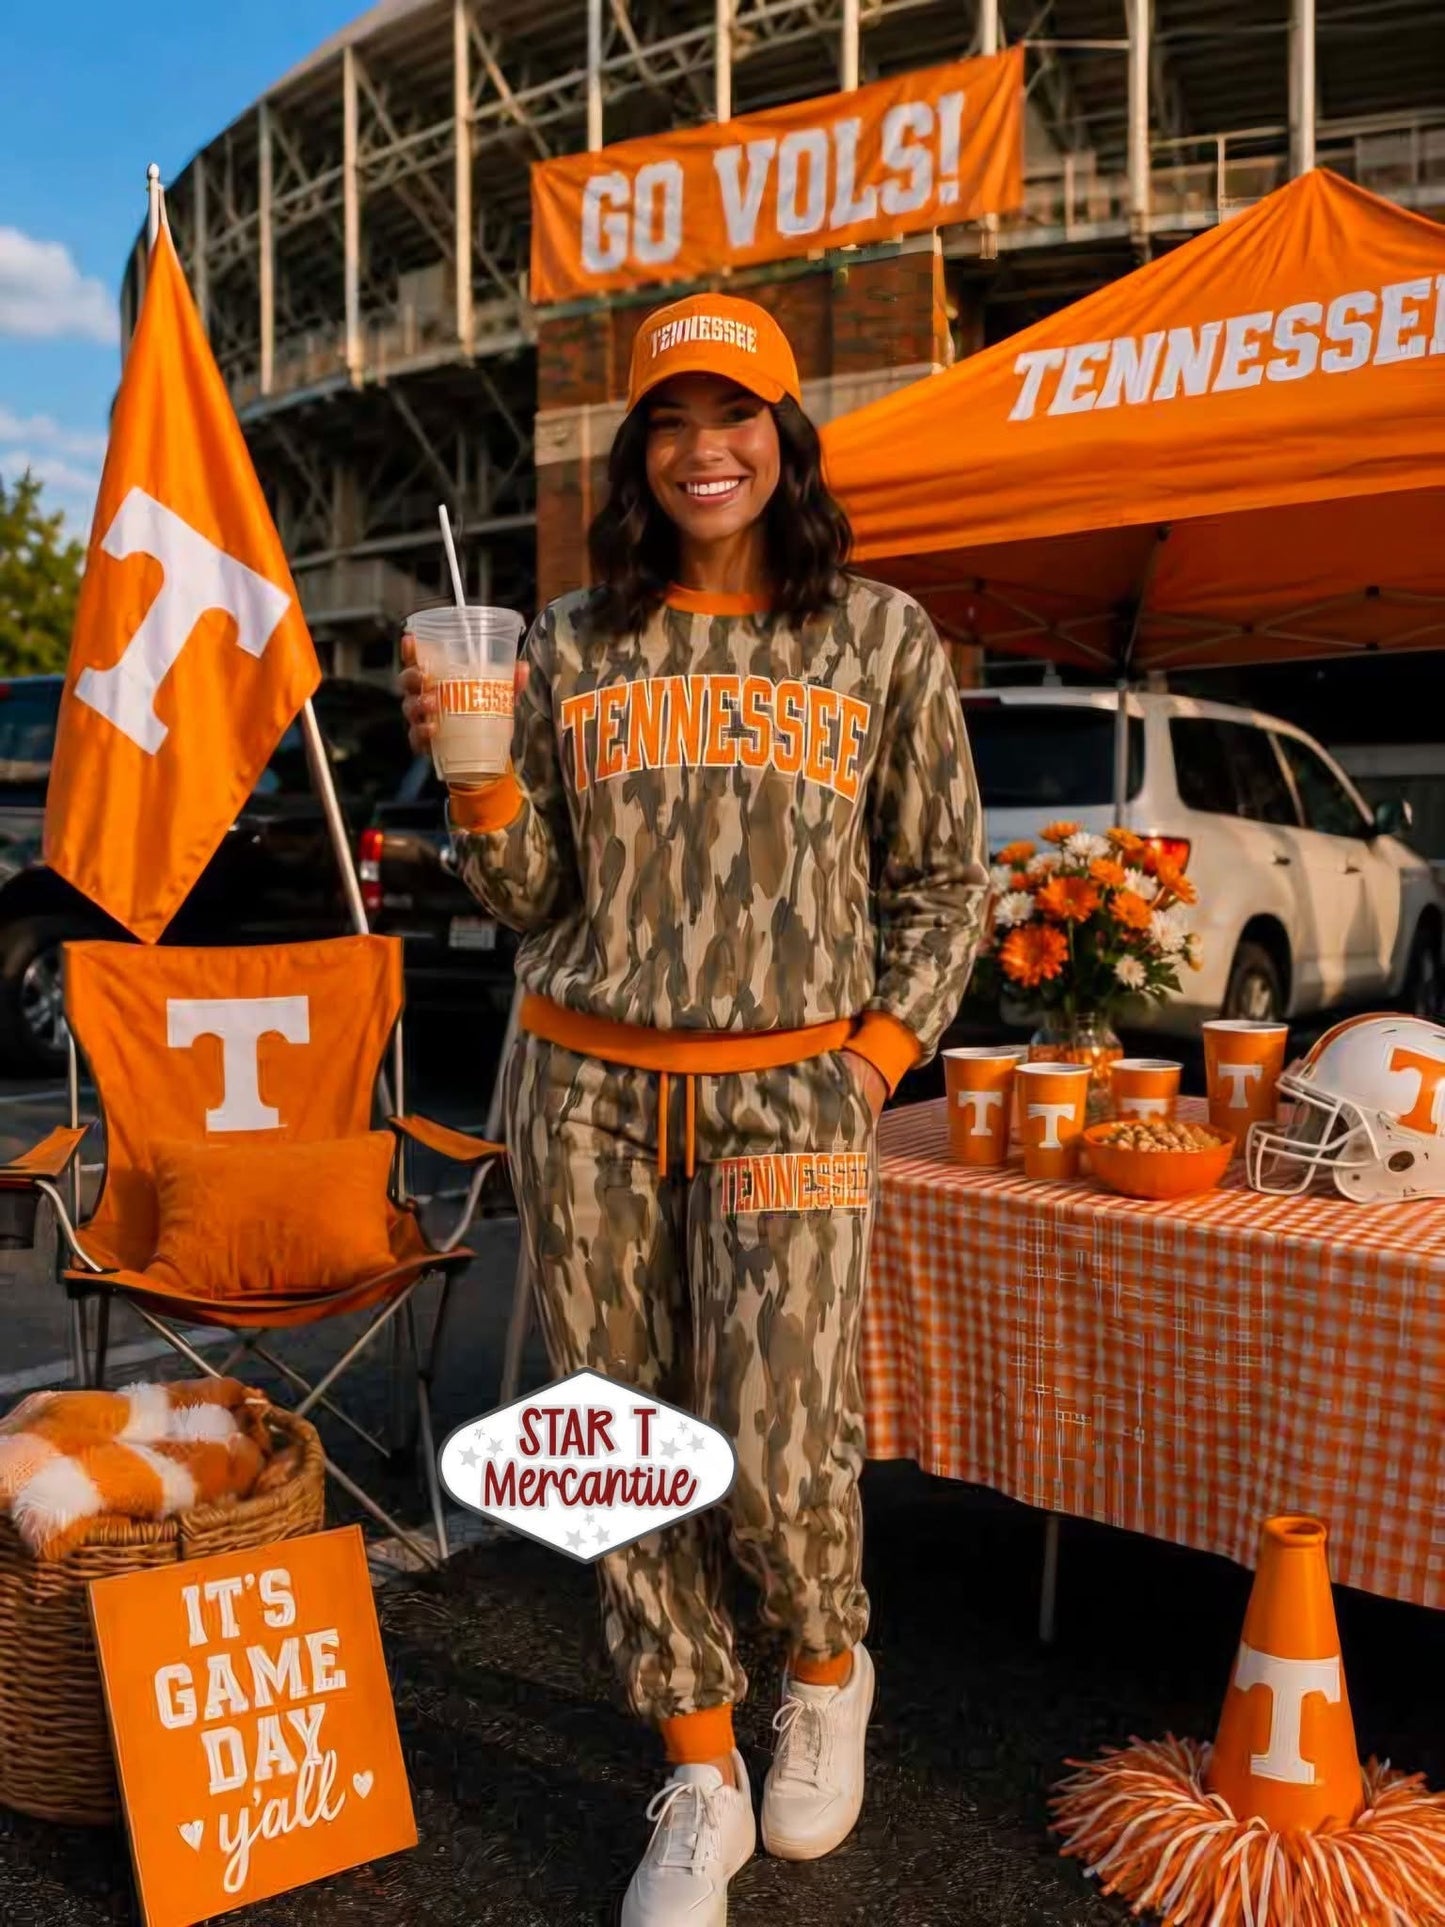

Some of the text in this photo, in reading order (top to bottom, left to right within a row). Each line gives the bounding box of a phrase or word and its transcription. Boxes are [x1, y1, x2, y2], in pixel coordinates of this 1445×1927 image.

[581, 91, 966, 274] GO VOLS!
[1007, 272, 1445, 421] TENNESSE
[74, 485, 291, 756] T
[561, 674, 871, 803] TENNESSEE
[167, 995, 310, 1132] T
[958, 1091, 1003, 1137] T
[1218, 1063, 1263, 1109] T
[1389, 1047, 1445, 1135] T
[1028, 1103, 1075, 1149] T
[181, 1568, 296, 1647] IT'S
[154, 1628, 346, 1730] GAME
[1234, 1640, 1340, 1784] T
[201, 1702, 326, 1796] DAY
[218, 1749, 346, 1893] y'all
